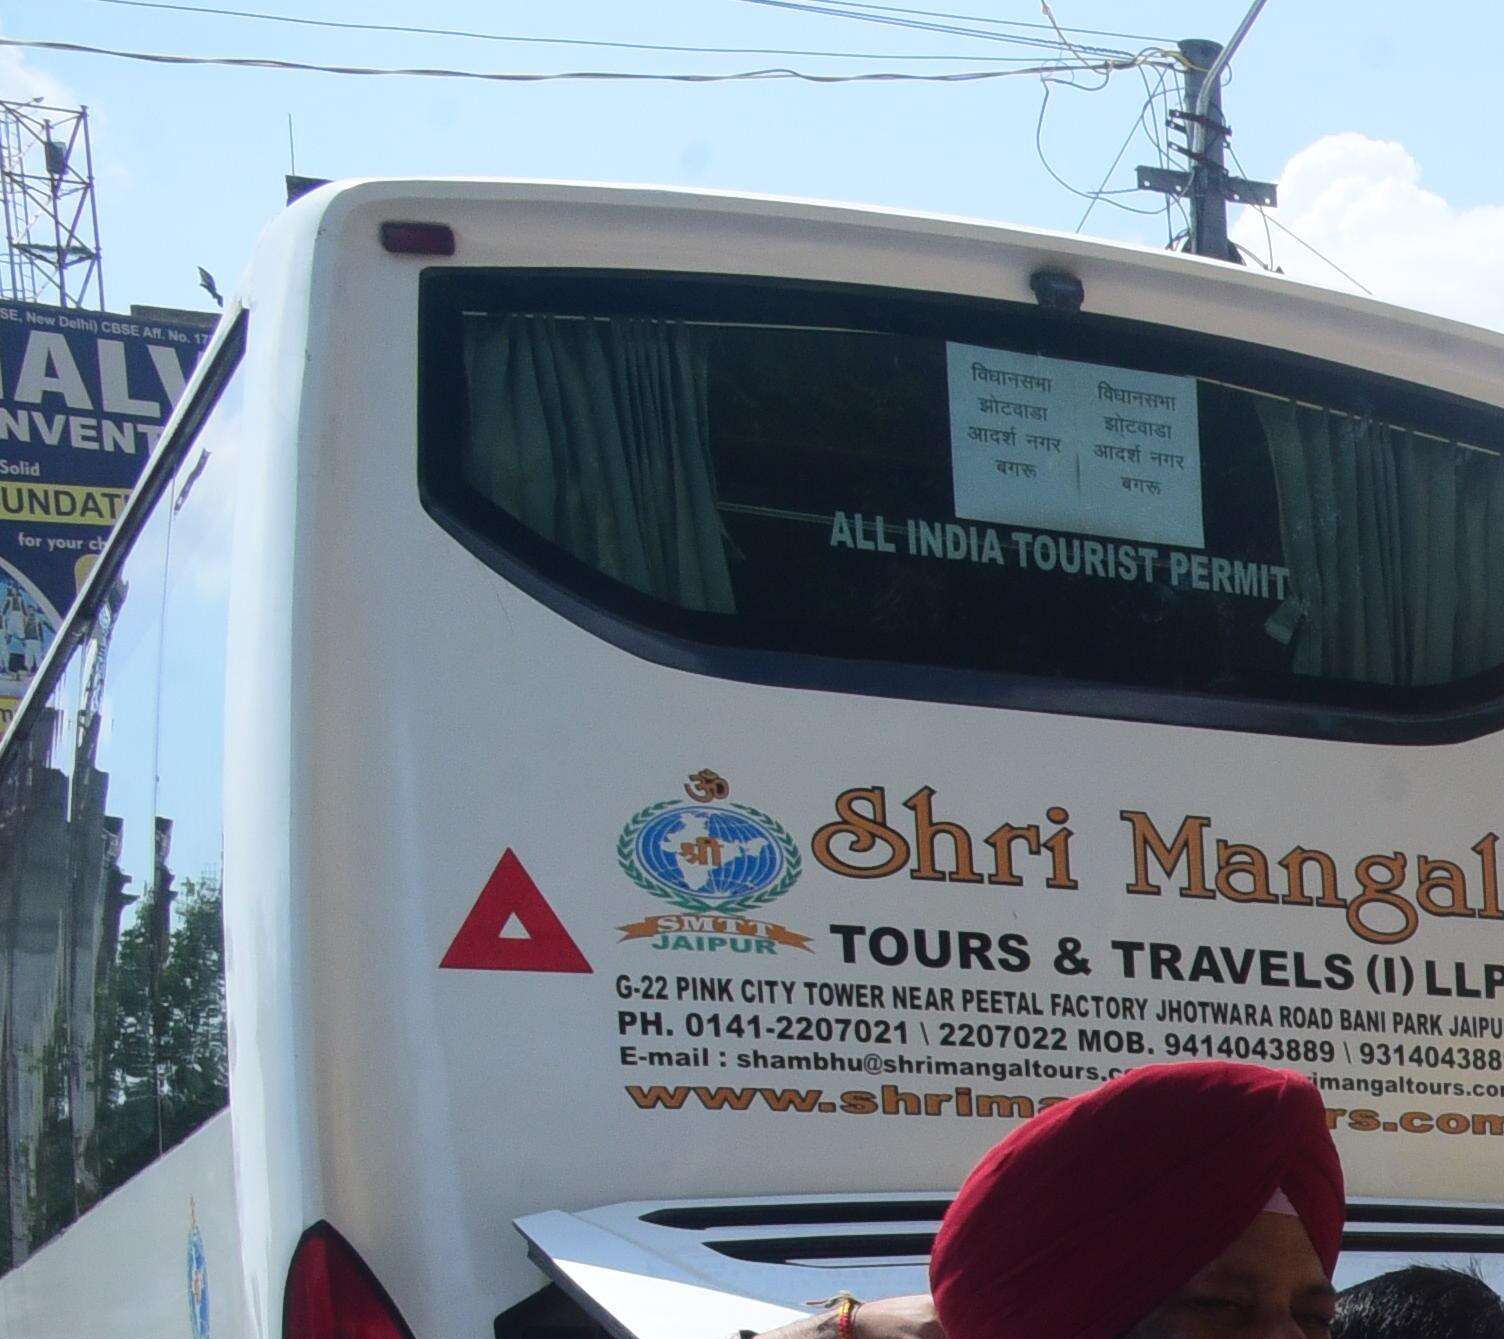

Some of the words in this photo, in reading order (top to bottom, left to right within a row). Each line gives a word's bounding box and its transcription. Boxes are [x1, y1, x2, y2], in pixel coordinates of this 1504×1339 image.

[26, 311, 56, 326] New
[59, 316, 98, 332] Delhi)
[101, 321, 140, 337] CBSE
[169, 330, 190, 344] No.
[971, 361, 1053, 393] विधानसभा
[1097, 381, 1176, 412] विधानसभा
[967, 425, 1016, 447] आदर्श
[1026, 433, 1061, 453] नगर
[0, 459, 40, 476] Solid
[996, 458, 1037, 478] बगरू
[1094, 443, 1141, 464] आदर्श
[1150, 451, 1184, 470] नगर
[1121, 476, 1162, 495] बगरू
[0, 485, 131, 519] UNDAT
[18, 532, 41, 547] for
[48, 538, 83, 552] your
[830, 511, 896, 553] ALL
[907, 519, 1003, 566] INDIA
[1011, 533, 1158, 583] TOURIST
[1169, 552, 1290, 601] PERMIT
[811, 785, 1079, 890] Shri
[656, 915, 773, 937] SMTT
[651, 934, 777, 955] JAIPUR
[829, 924, 1031, 972] TOURS
[1053, 937, 1092, 976] &
[1111, 940, 1355, 991] TRAVELS
[1367, 953, 1415, 995] (I)
[616, 974, 669, 1000] G-22
[676, 976, 734, 1003] PINK
[741, 979, 796, 1005] CITY
[804, 982, 885, 1009] TOWER
[892, 985, 955, 1012] NEAR
[962, 989, 1044, 1016] PEETAL
[1051, 993, 1149, 1021] FACTORY
[1156, 999, 1273, 1028] JHOTWARA
[1279, 1005, 1333, 1030] ROAD
[1340, 1008, 1386, 1033] BANI
[1393, 1010, 1443, 1037] PARK
[618, 1011, 673, 1036] PH.
[685, 1012, 908, 1045] 0141-2207021
[939, 1023, 1068, 1051] 2207022
[1078, 1029, 1155, 1055] MOB.
[1164, 1032, 1335, 1064] 9414043889
[620, 1046, 709, 1068] E-mail
